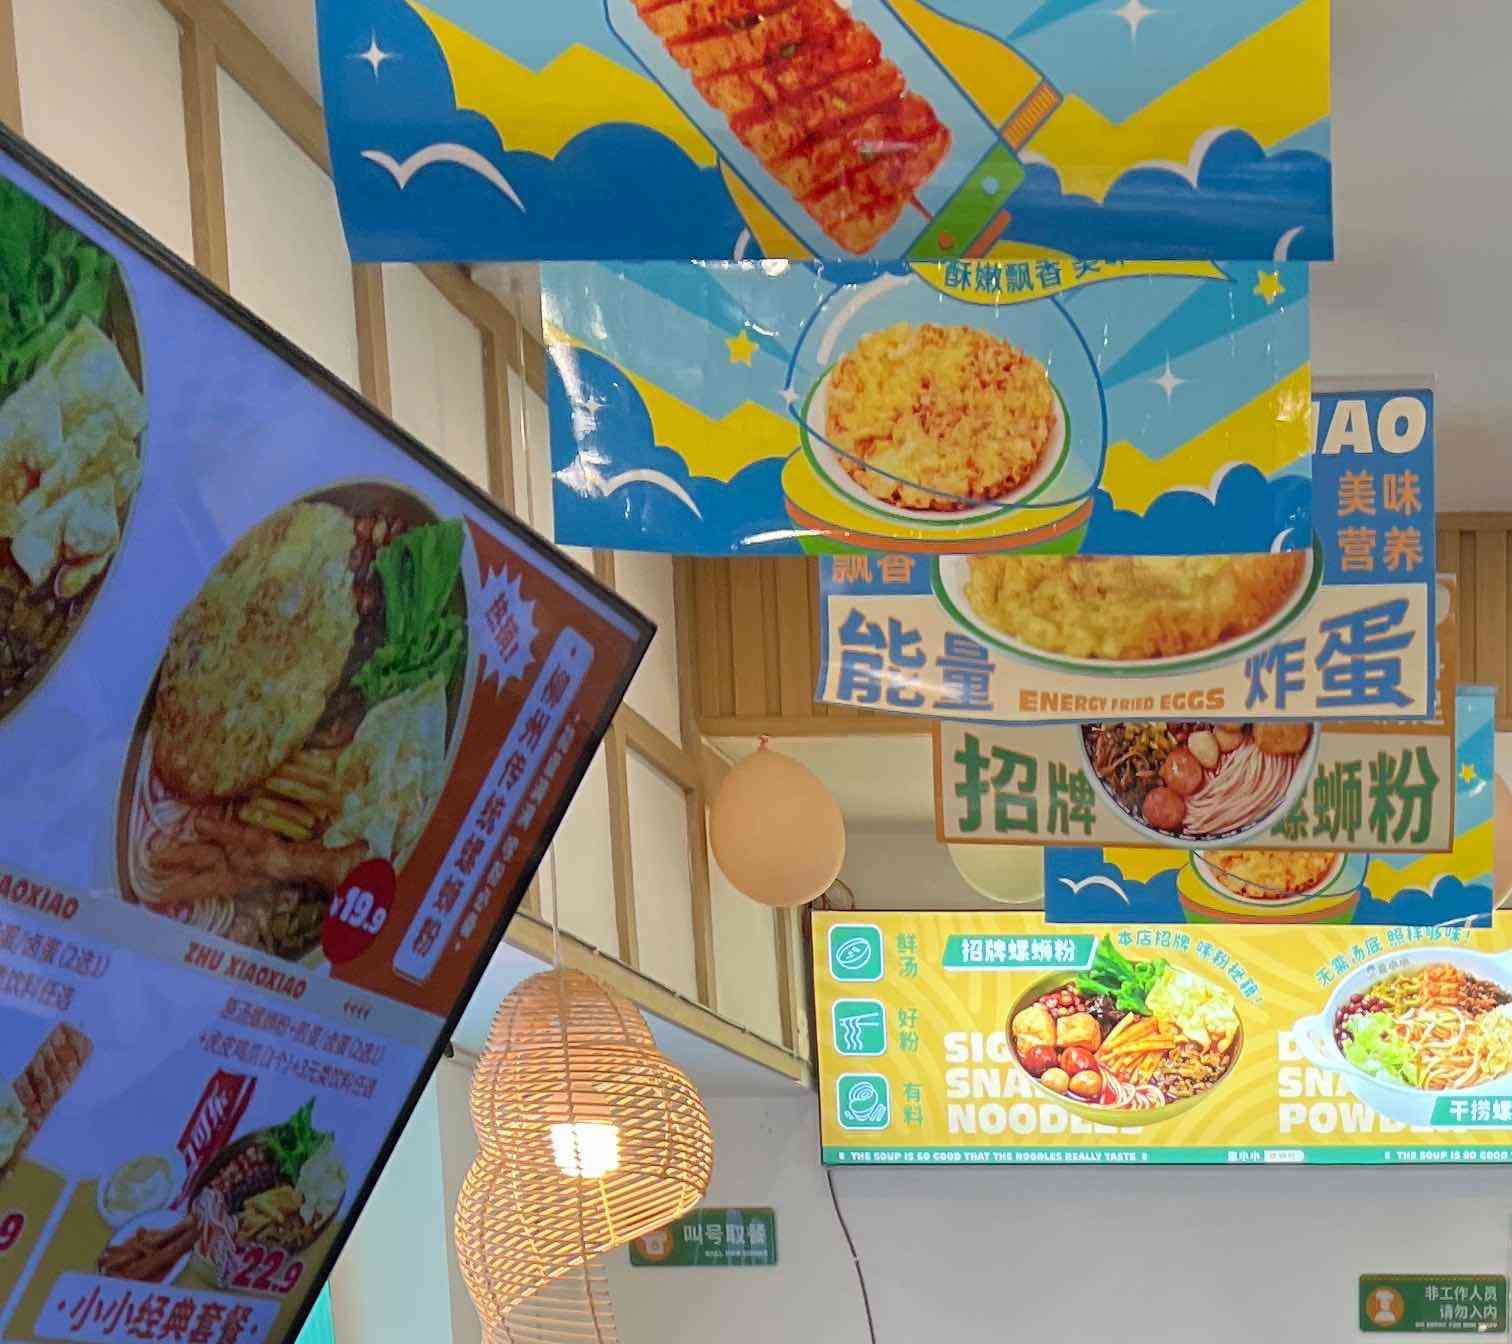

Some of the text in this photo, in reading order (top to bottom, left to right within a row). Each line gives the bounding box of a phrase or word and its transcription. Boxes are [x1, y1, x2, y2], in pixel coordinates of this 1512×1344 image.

[944, 261, 1063, 293] 酥嫩飘香
[1337, 472, 1421, 516] 美味
[1337, 527, 1423, 573] 营养
[837, 598, 1415, 713] 能量 炸蛋
[1019, 687, 1226, 713] ENERGY FRIED EGGS
[953, 733, 1097, 837] 招牌
[961, 938, 1078, 964] 招牌螺蛳粉
[1118, 930, 1190, 952] 本店招牌
[184, 940, 308, 1000] ZHU XIAOXIAO
[898, 1008, 919, 1054] 好粉
[902, 1082, 923, 1128] 有料
[1425, 1285, 1497, 1302] 非工作人员
[1440, 1304, 1497, 1320] 请勿入内
